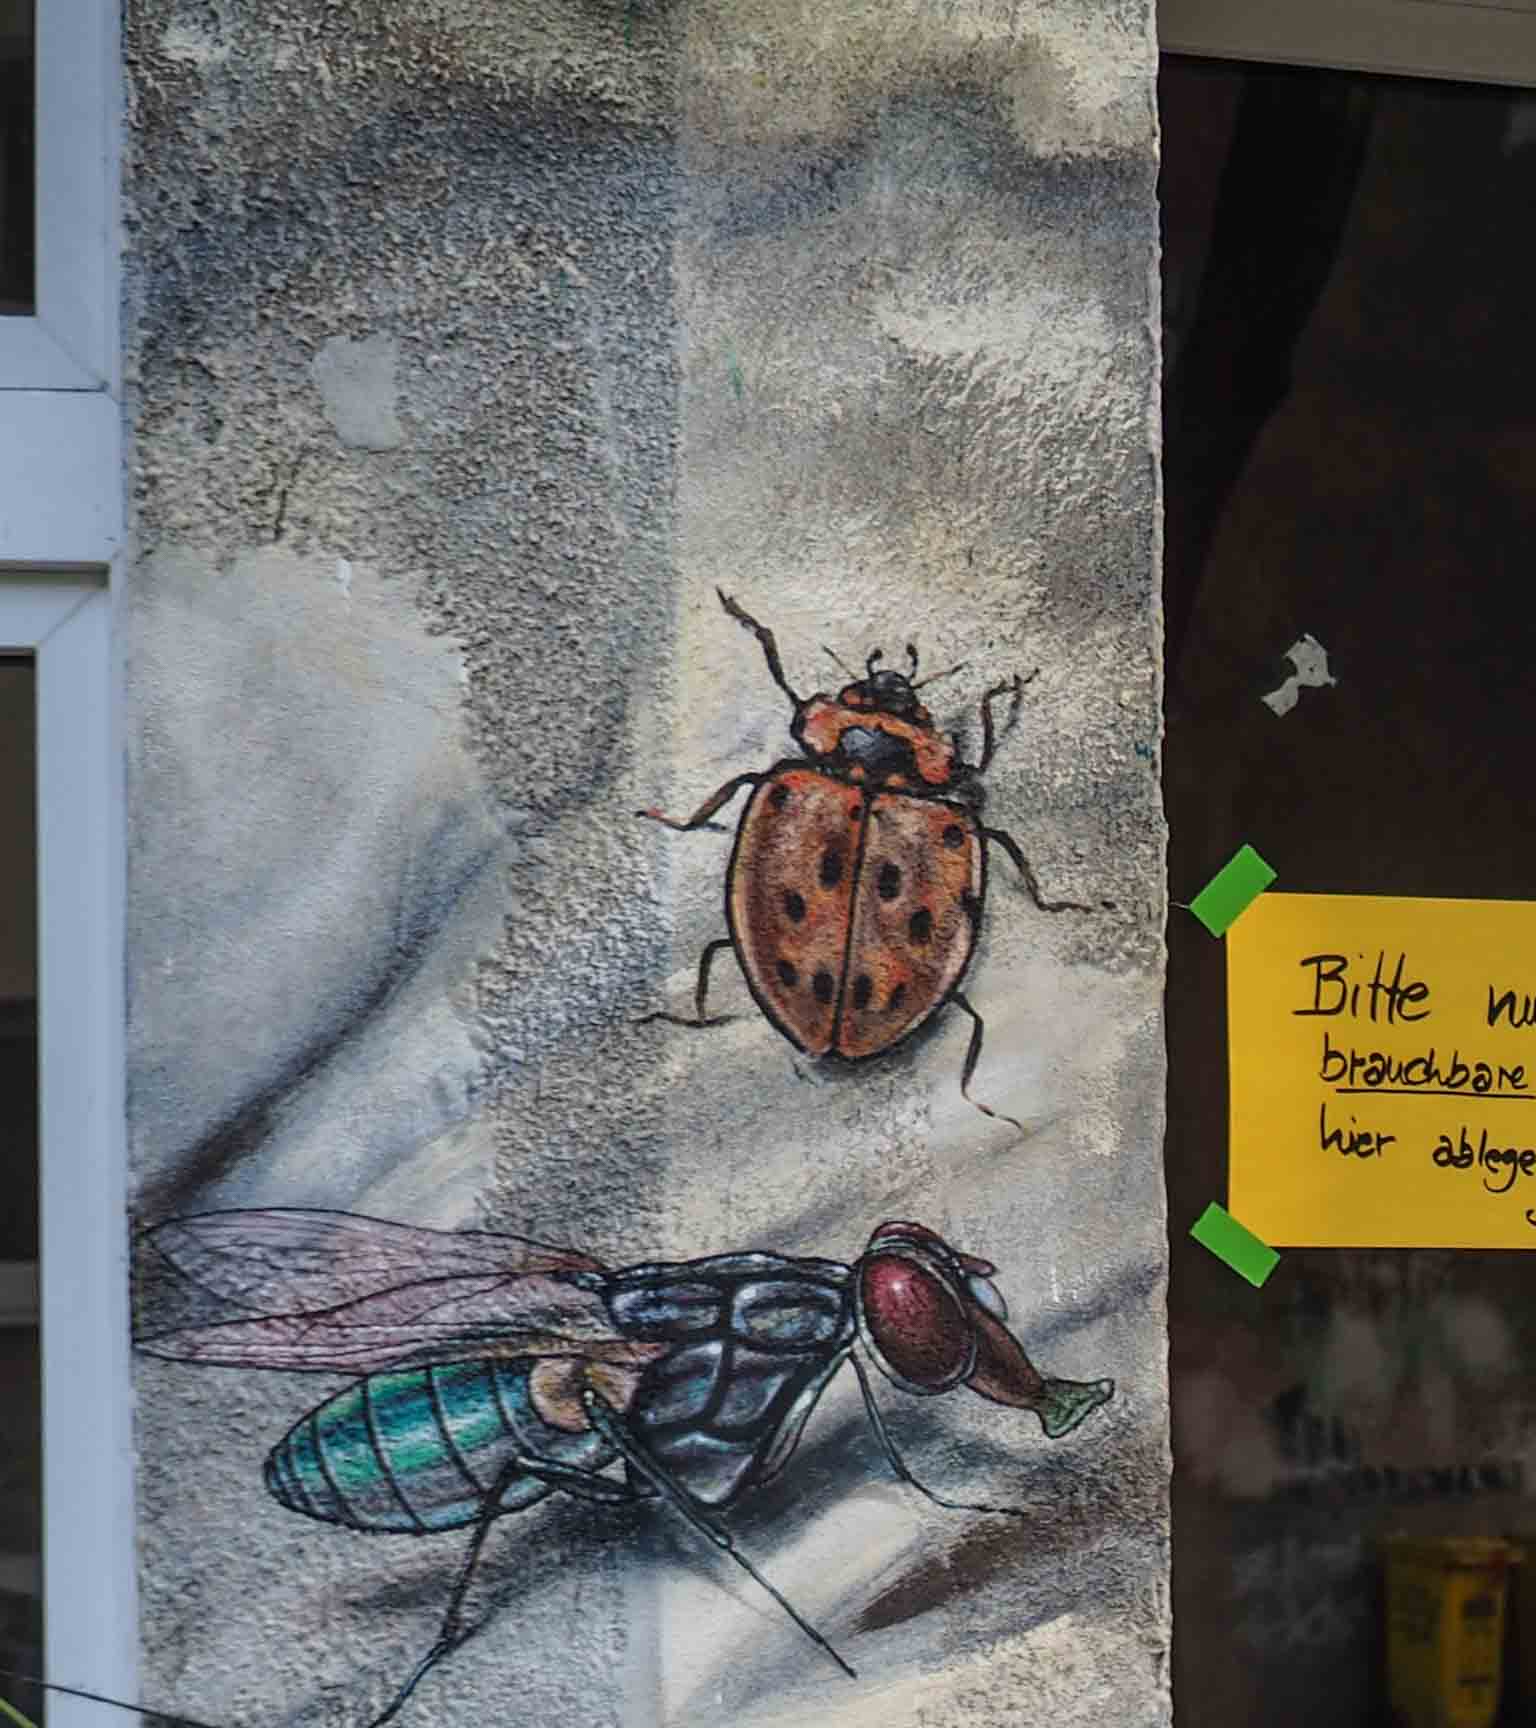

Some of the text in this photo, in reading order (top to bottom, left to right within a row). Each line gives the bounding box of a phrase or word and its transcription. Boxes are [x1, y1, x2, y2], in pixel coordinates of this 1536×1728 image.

[1292, 949, 1431, 1025] Bitte
[1319, 1032, 1530, 1093] brauchbare
[1319, 1103, 1397, 1159] hier
